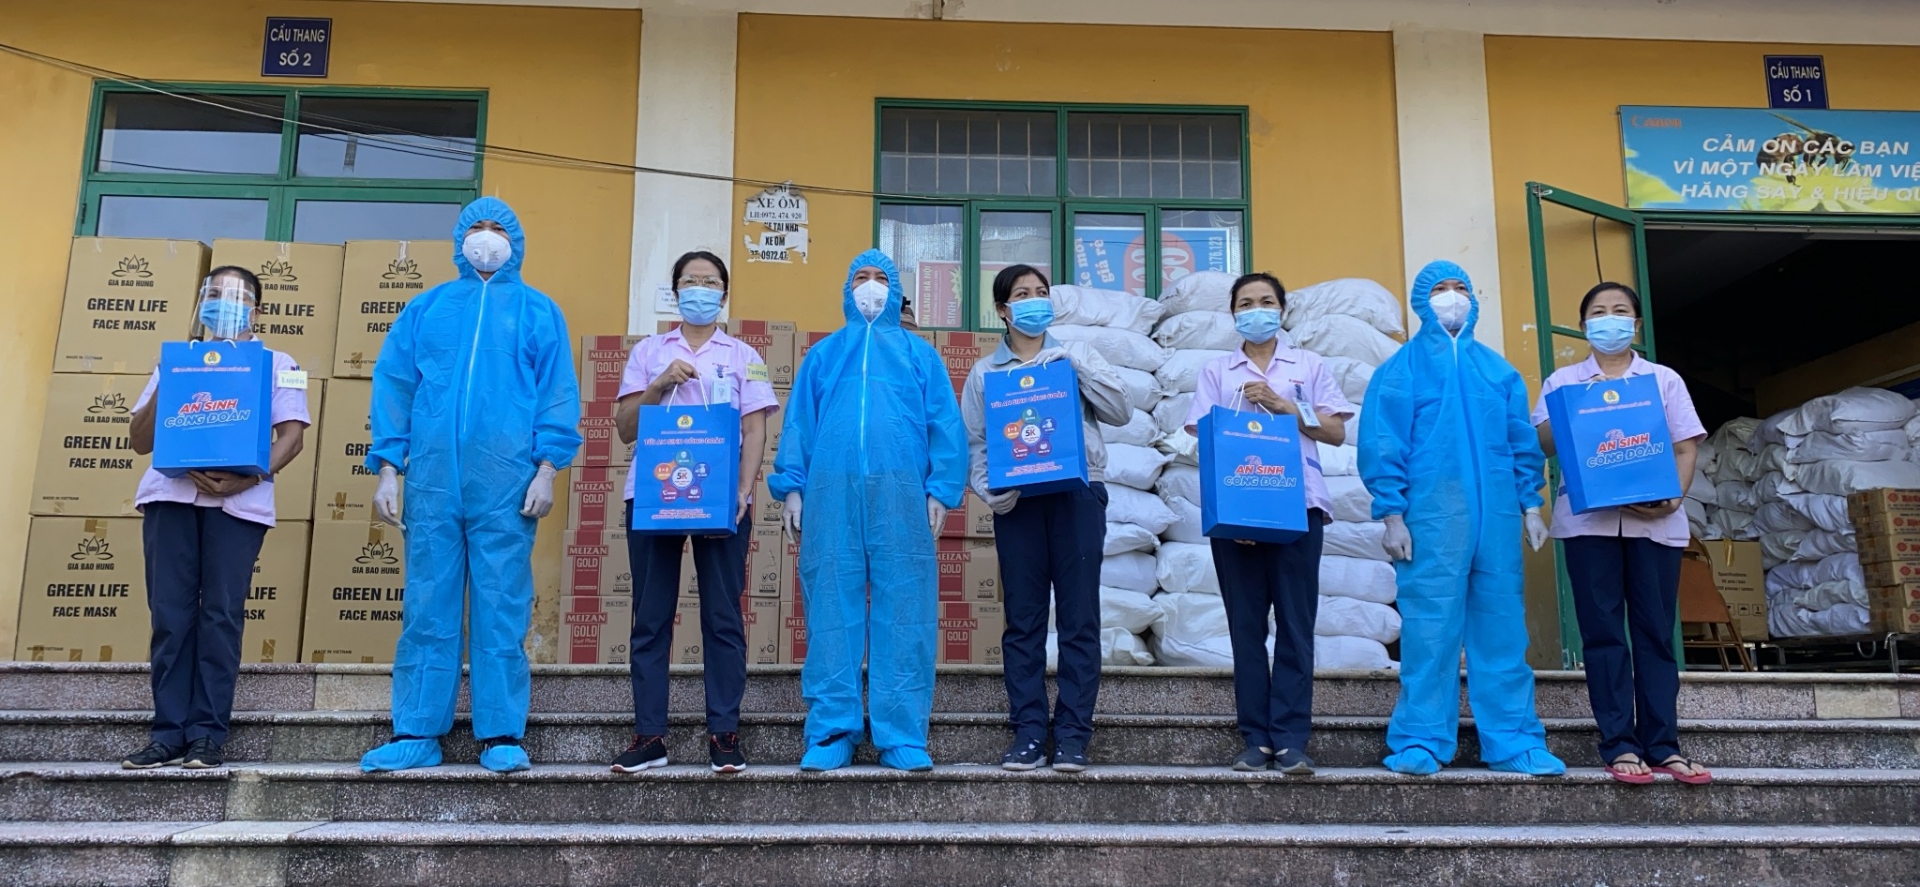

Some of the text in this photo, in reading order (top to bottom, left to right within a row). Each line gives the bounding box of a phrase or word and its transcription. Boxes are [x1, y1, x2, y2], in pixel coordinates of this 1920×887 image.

[293, 29, 325, 42] THANG
[279, 48, 312, 66] SỐ 2
[1791, 66, 1820, 79] THANG
[1784, 84, 1812, 101] SỐ 1
[1631, 116, 1682, 128] Canon
[1703, 134, 1909, 157] CẢM ƠN CÁC BẠN
[1674, 158, 1694, 174] VÌ
[1701, 158, 1753, 178] MỘT
[1759, 160, 1826, 176] NGÀY
[1833, 162, 1882, 178] LÀM
[1681, 181, 1748, 198] HĂNG
[1757, 186, 1803, 199] SAY
[1812, 187, 1824, 199] &
[1834, 185, 1888, 203] HIỆU
[757, 196, 799, 208] XE ÔM
[765, 236, 773, 246] XE
[762, 250, 789, 260] 0972.47
[87, 298, 168, 312] GREEN LIFE
[286, 304, 315, 317] LIFE
[361, 302, 405, 313] GREEN
[947, 302, 956, 324] SINH
[93, 319, 156, 330] FACE MASK
[252, 324, 304, 335] CE MASK
[367, 323, 392, 332] FACE
[943, 348, 978, 356] MEIZAN
[597, 362, 620, 372] GOLD
[950, 358, 971, 369] GOLD
[178, 398, 238, 414] AN SINH
[164, 409, 251, 428] CÔNG ĐOÀN
[588, 429, 609, 438] GOLD
[64, 436, 132, 449] GREEN LI
[1596, 433, 1650, 454] AN SINH
[345, 443, 372, 456] GRE
[1587, 442, 1664, 468] CÔNG ĐOÀN
[69, 458, 133, 469] FACE MASK
[1235, 465, 1285, 475] AN SINH
[1224, 474, 1297, 487] CÔNG ĐOÀN
[583, 494, 604, 503] GOLD
[577, 558, 598, 568] GOLD
[941, 564, 961, 574] GOLD
[47, 584, 129, 597] GREEN LIFE
[247, 587, 277, 600] LIFE
[333, 587, 382, 601] GREEN
[53, 607, 117, 617] FACE MASK
[244, 609, 265, 620] ASK
[339, 610, 403, 621] FACE MASK
[567, 614, 606, 622] MEIZAN
[574, 625, 597, 637] GOLD
[795, 630, 806, 639] GO
[947, 631, 968, 641] GOLD
